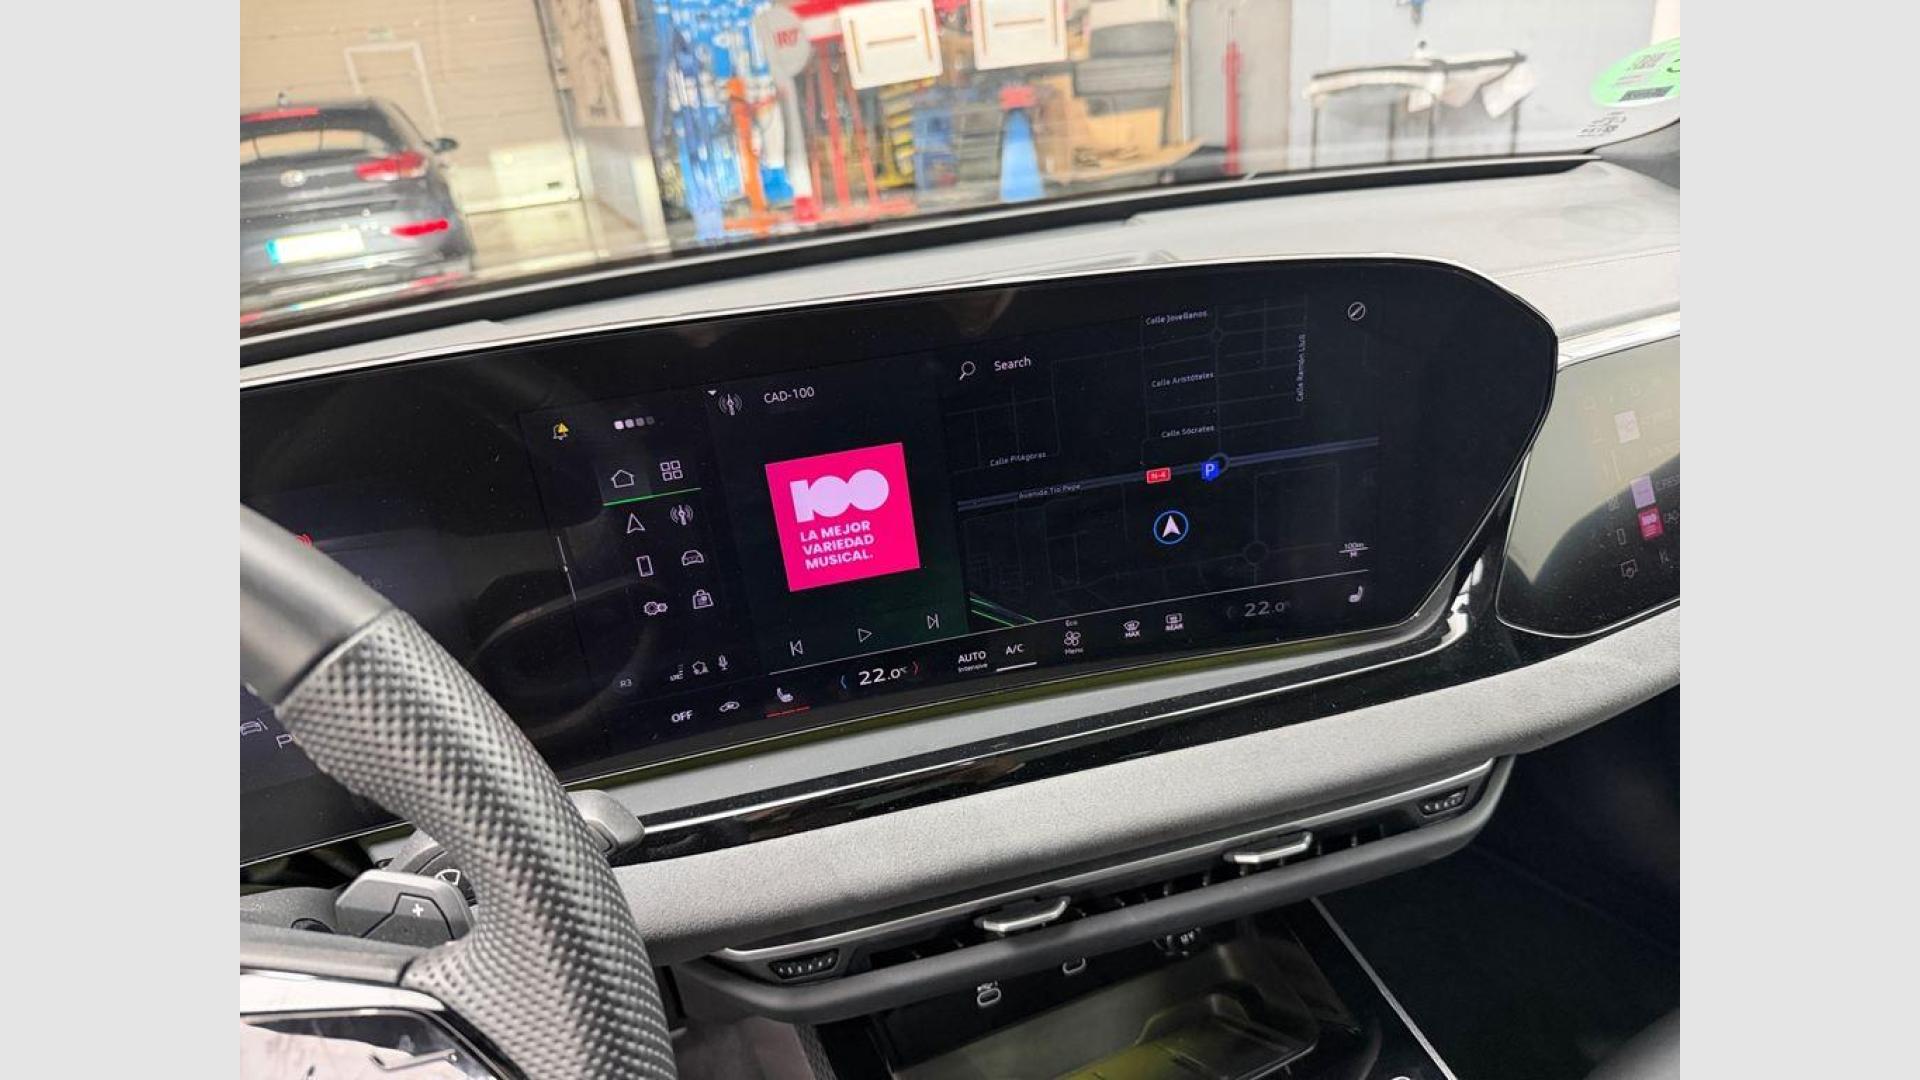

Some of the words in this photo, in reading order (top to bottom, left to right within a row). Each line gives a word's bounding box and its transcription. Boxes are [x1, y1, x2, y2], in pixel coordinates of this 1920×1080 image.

[993, 355, 1031, 371] Search
[763, 386, 815, 404] CAD-100
[789, 469, 890, 523] 100
[800, 529, 819, 542] LA
[820, 519, 871, 540] MEJOR
[802, 533, 875, 556] VARIEDAD
[804, 549, 874, 571] MUSICAL.
[958, 650, 987, 664] AUTO
[1005, 643, 1026, 656] A/C
[671, 709, 694, 723] OFF
